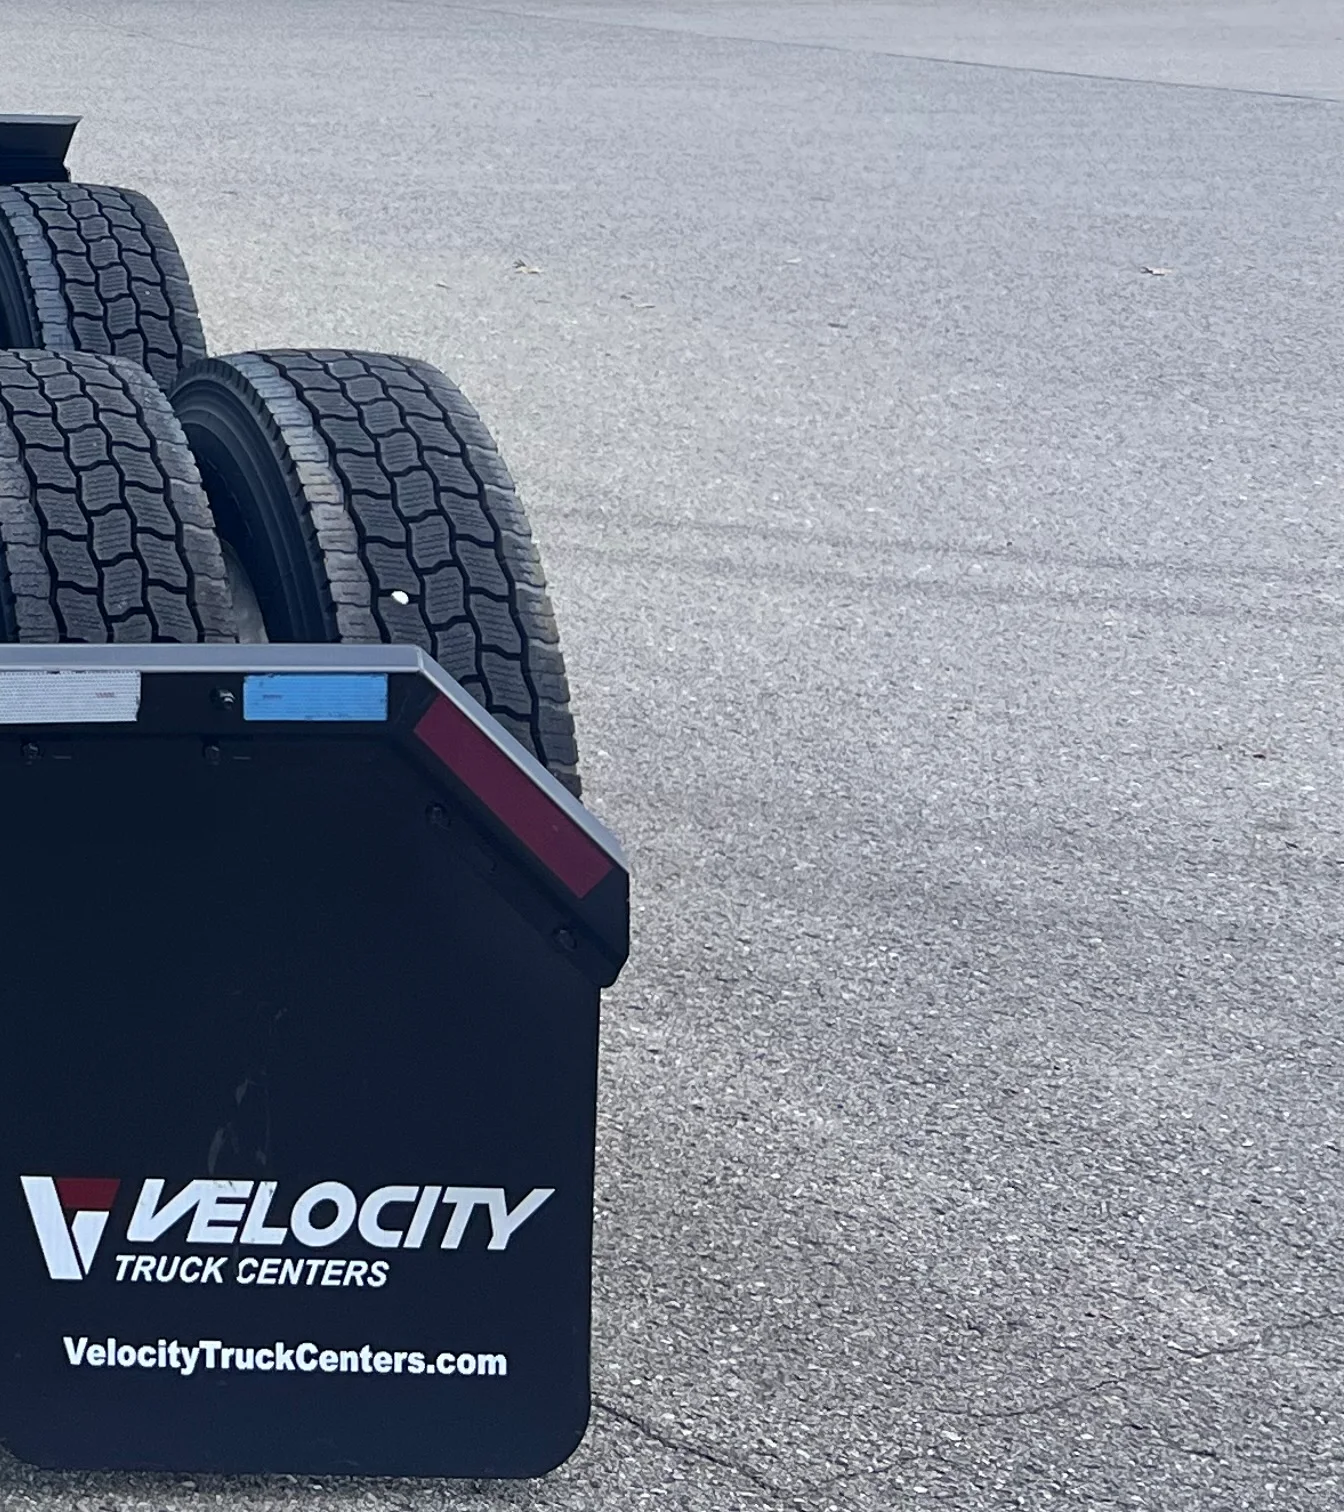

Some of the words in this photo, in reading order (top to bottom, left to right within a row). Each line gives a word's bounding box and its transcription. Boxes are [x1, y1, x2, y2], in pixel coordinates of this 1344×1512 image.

[126, 1177, 556, 1251] VELOCITY
[114, 1255, 229, 1284] TRUCK
[235, 1257, 391, 1288] CENTERS
[62, 1336, 507, 1376] VelocityTruckCenters.com
